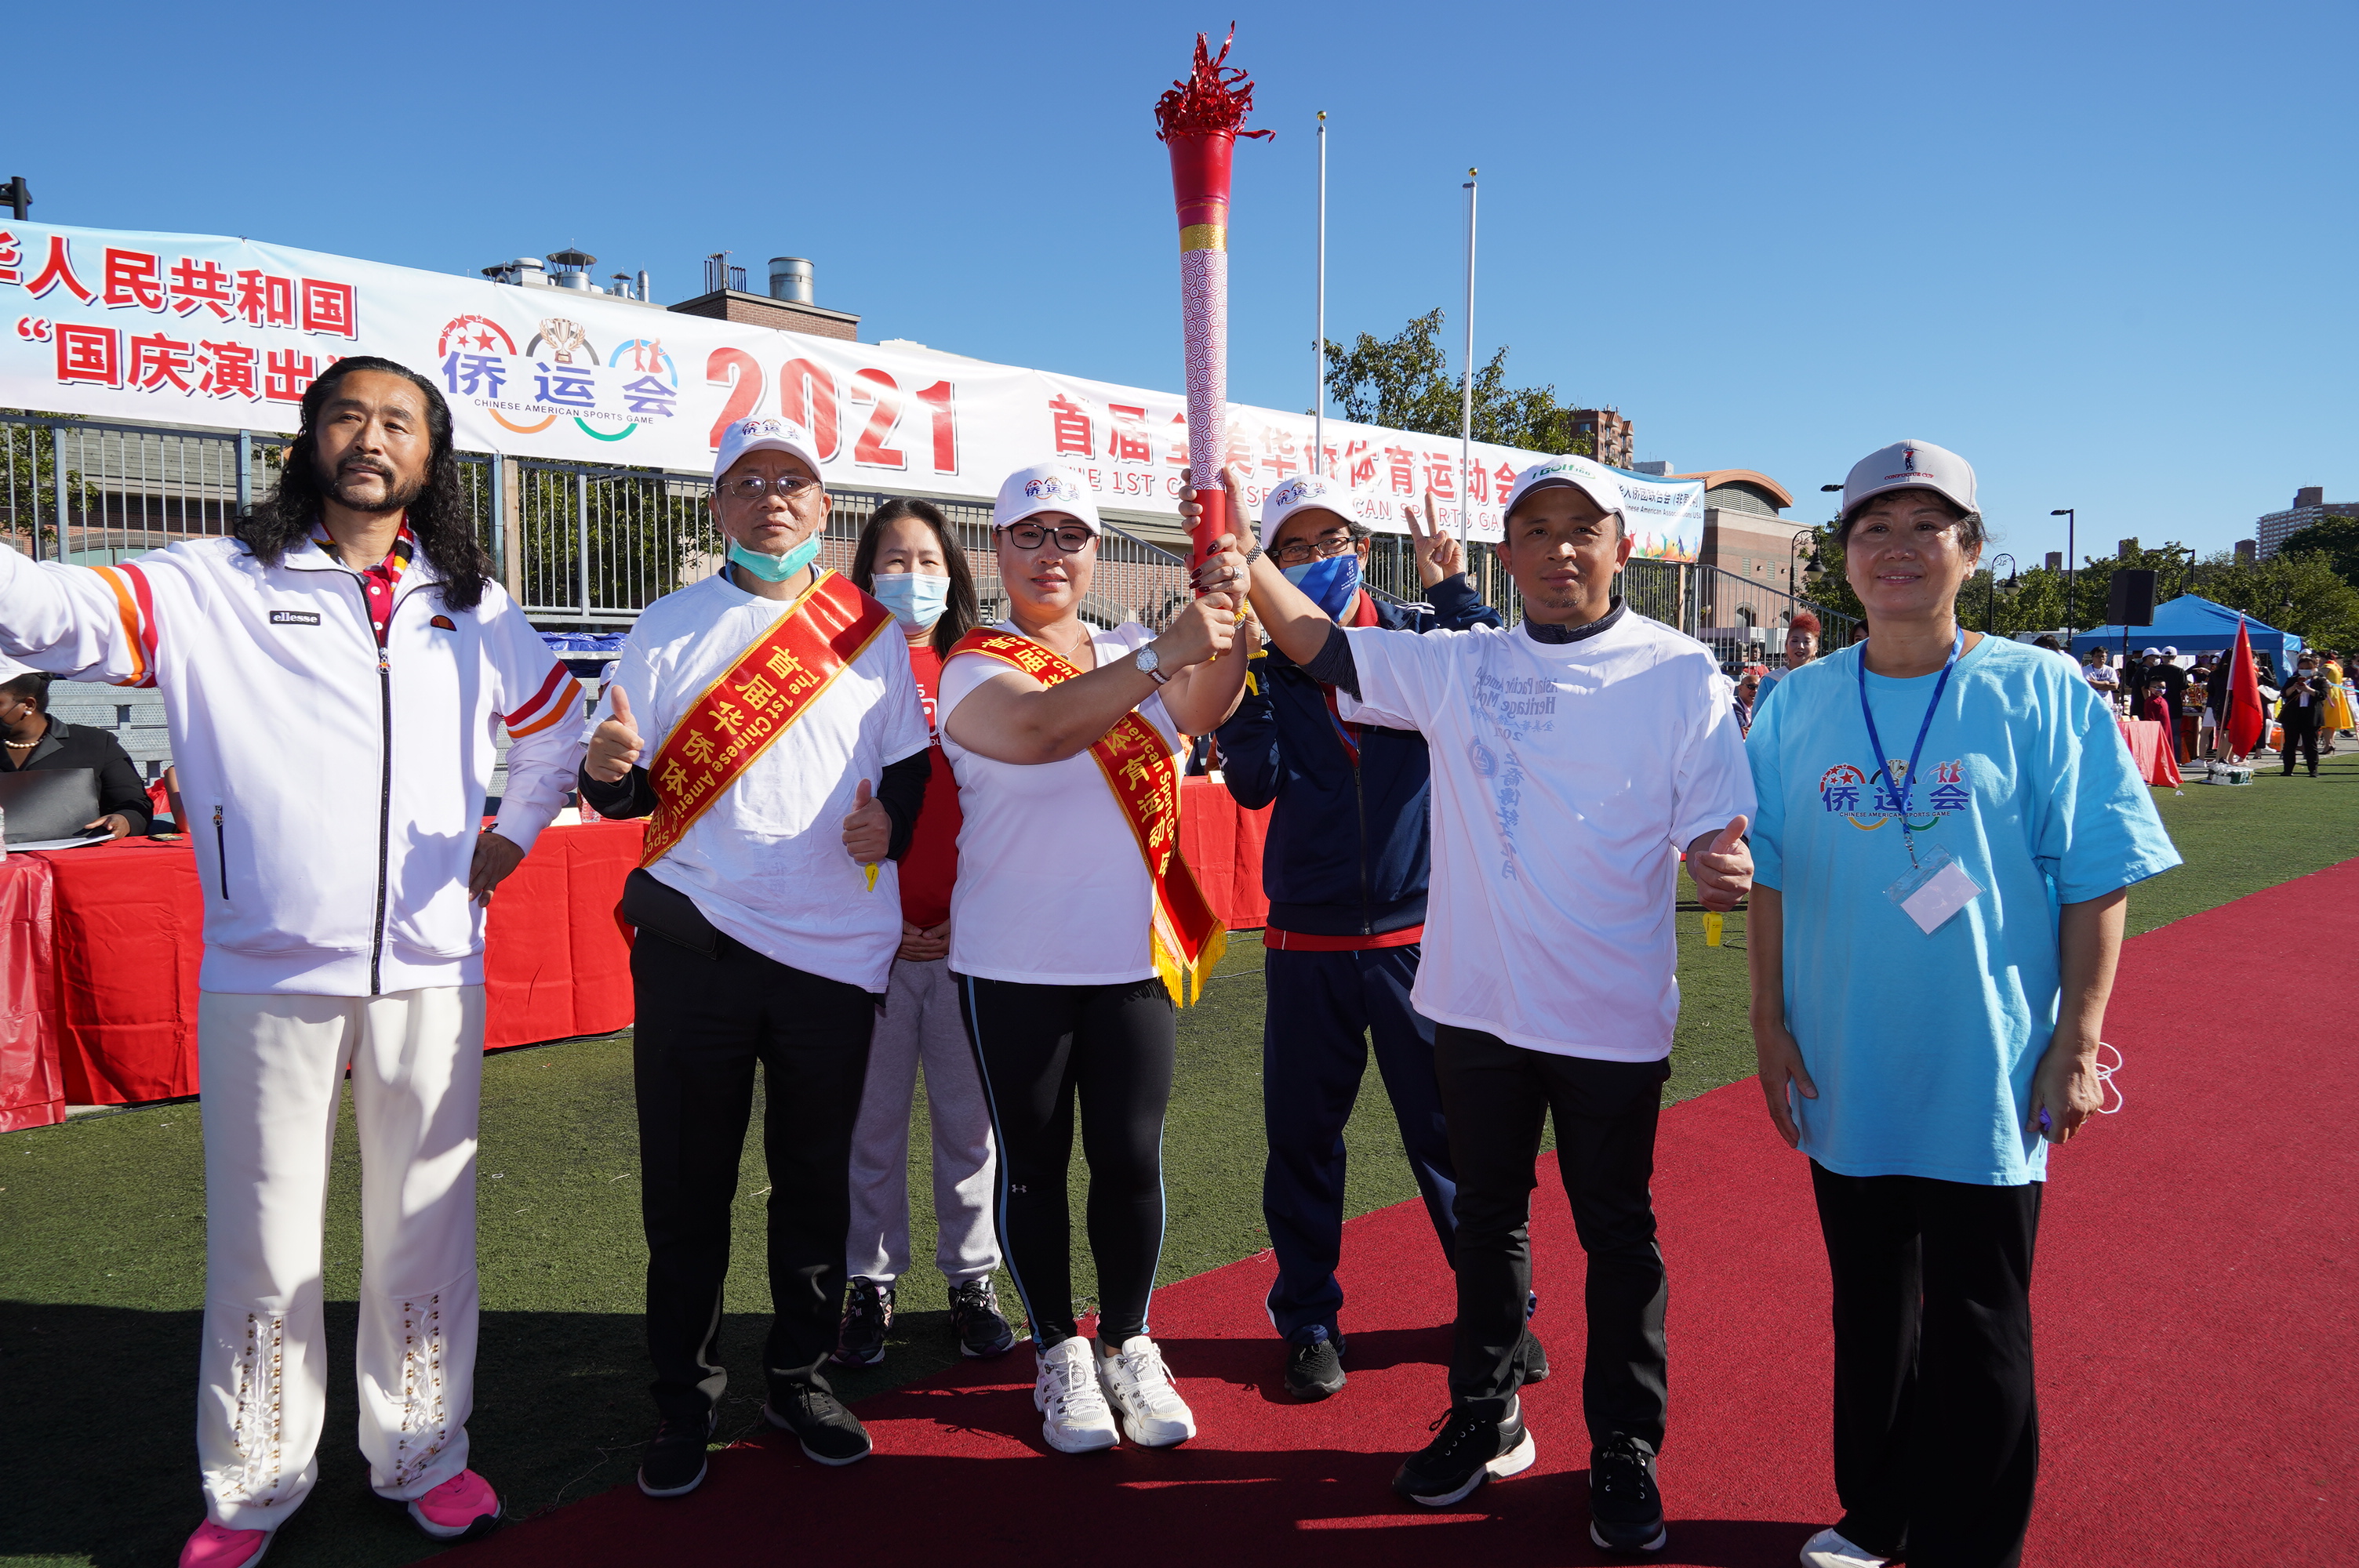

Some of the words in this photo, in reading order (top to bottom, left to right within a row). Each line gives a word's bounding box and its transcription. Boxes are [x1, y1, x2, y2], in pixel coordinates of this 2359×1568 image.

[442, 350, 678, 418] 侨运会
[474, 398, 522, 411] CHINESE
[525, 405, 580, 416] AMERICAN
[583, 410, 623, 421] SPORTS
[627, 415, 654, 424] GAME
[707, 347, 958, 474] 2021
[1113, 471, 1154, 496] 1ST
[1400, 503, 1472, 528] SPRT
[1625, 503, 1639, 513] hinese
[273, 612, 318, 623] ellesse
[1030, 645, 1052, 661] 1st
[788, 669, 820, 695] The
[765, 694, 794, 720] 1st
[711, 716, 772, 772] Chinese
[1120, 717, 1165, 773] merican
[1822, 784, 1971, 812] 侨运会
